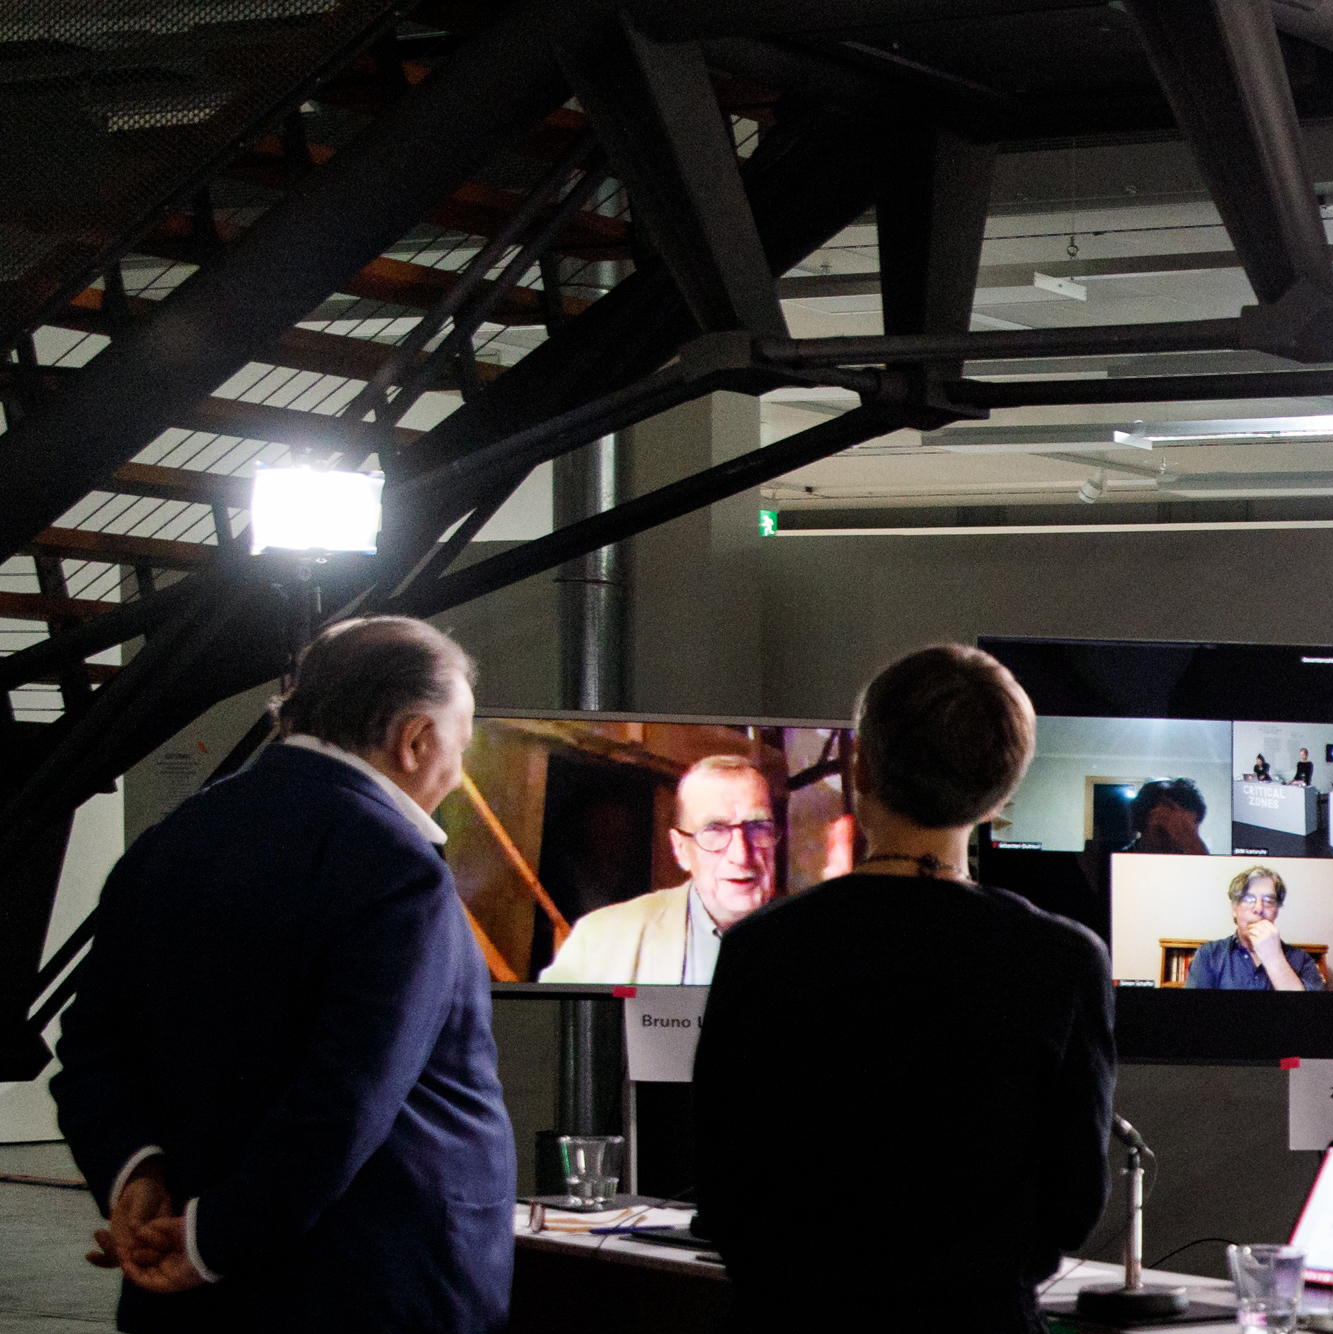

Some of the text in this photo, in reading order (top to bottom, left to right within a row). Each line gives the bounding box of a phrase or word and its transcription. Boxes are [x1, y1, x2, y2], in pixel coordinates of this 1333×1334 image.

[1243, 784, 1286, 799] CRITICAL
[1249, 796, 1280, 810] ZONES
[642, 1013, 691, 1028] Bruno
